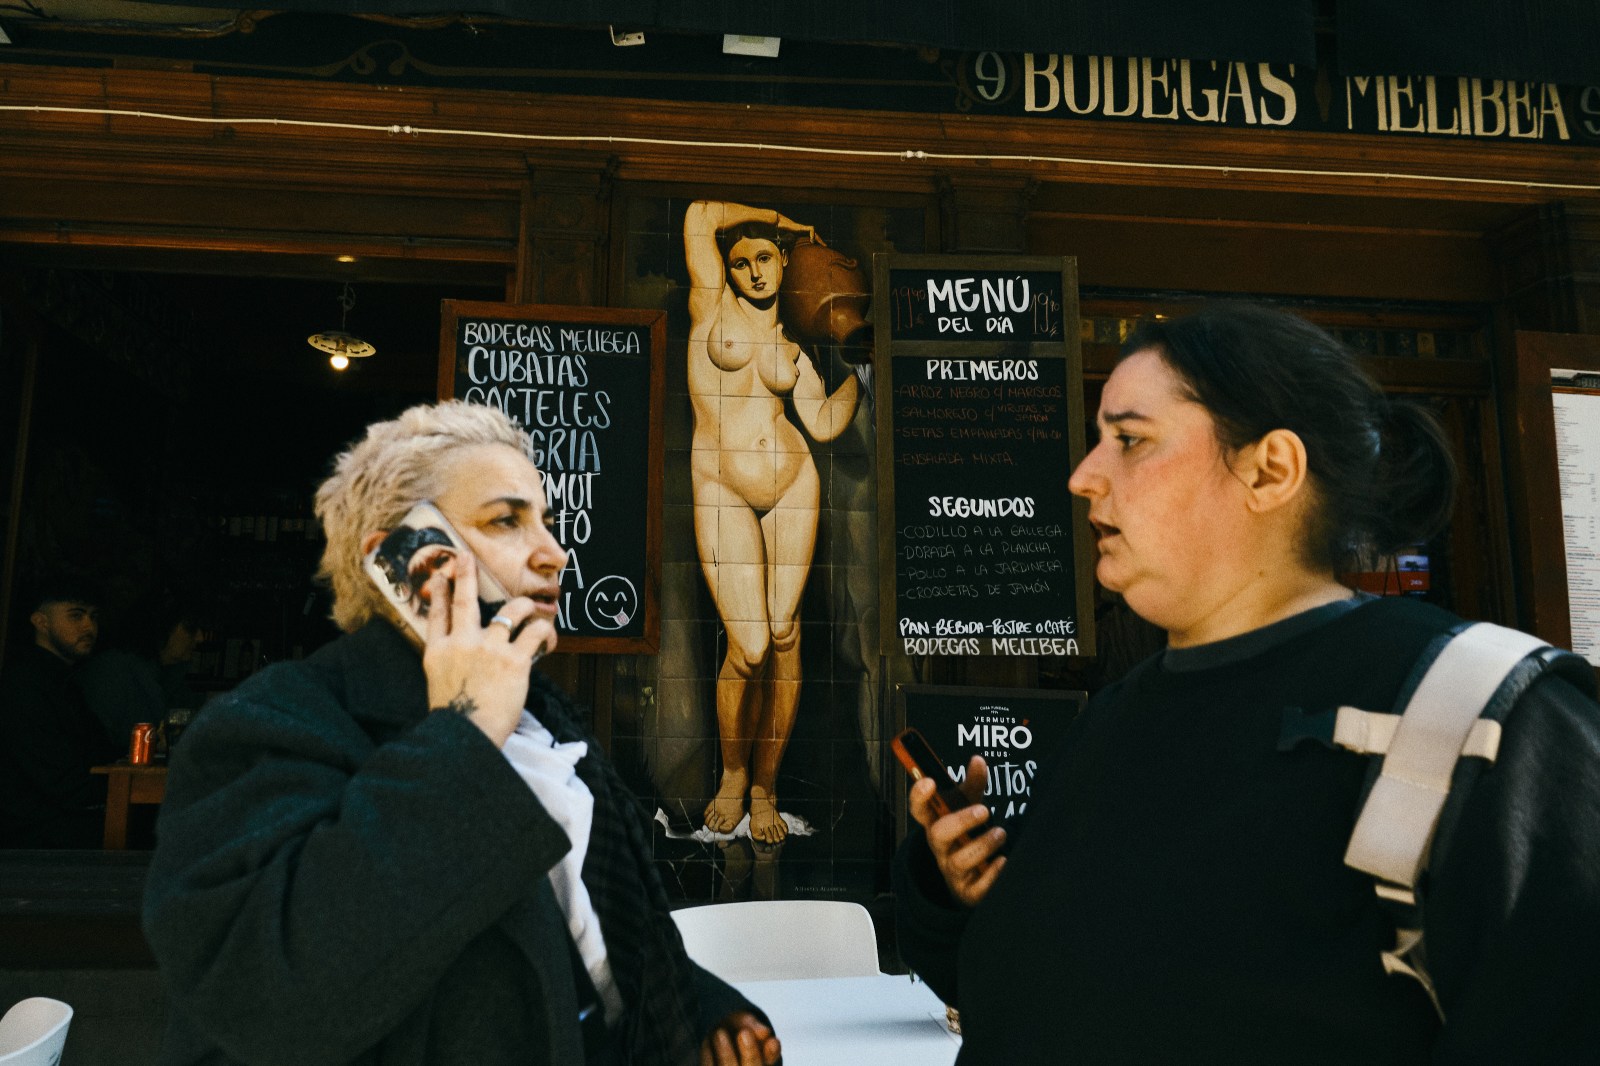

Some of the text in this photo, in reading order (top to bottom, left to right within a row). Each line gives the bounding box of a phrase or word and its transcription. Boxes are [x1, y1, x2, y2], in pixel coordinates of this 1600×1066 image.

[1024, 52, 1297, 127] BODEGAS
[1346, 75, 1570, 141] MELIBEA
[926, 276, 1030, 314] MENÚ
[937, 315, 1014, 334] DEL DÍA
[464, 322, 640, 354] BODEGAS MELIBEA
[468, 346, 589, 388] CUBATAS
[926, 359, 1039, 381] PRIMEROS
[950, 386, 990, 399] NEGRO
[1008, 385, 1062, 399] MARISCOS
[529, 428, 601, 471] GRIA
[540, 470, 601, 510] MUT
[928, 496, 1035, 518] SEGUNDOS
[973, 525, 983, 536] A
[988, 526, 1003, 537] LA
[963, 543, 973, 556] A
[979, 542, 994, 556] LA
[956, 564, 966, 576] A
[974, 564, 988, 576] LA
[986, 584, 1001, 596] DE
[904, 637, 1080, 656] BODEGAS MELIBEA
[974, 716, 1016, 724] VERMUTS
[957, 719, 1033, 750] MIRÓ
[947, 760, 1038, 798] MJITOS
